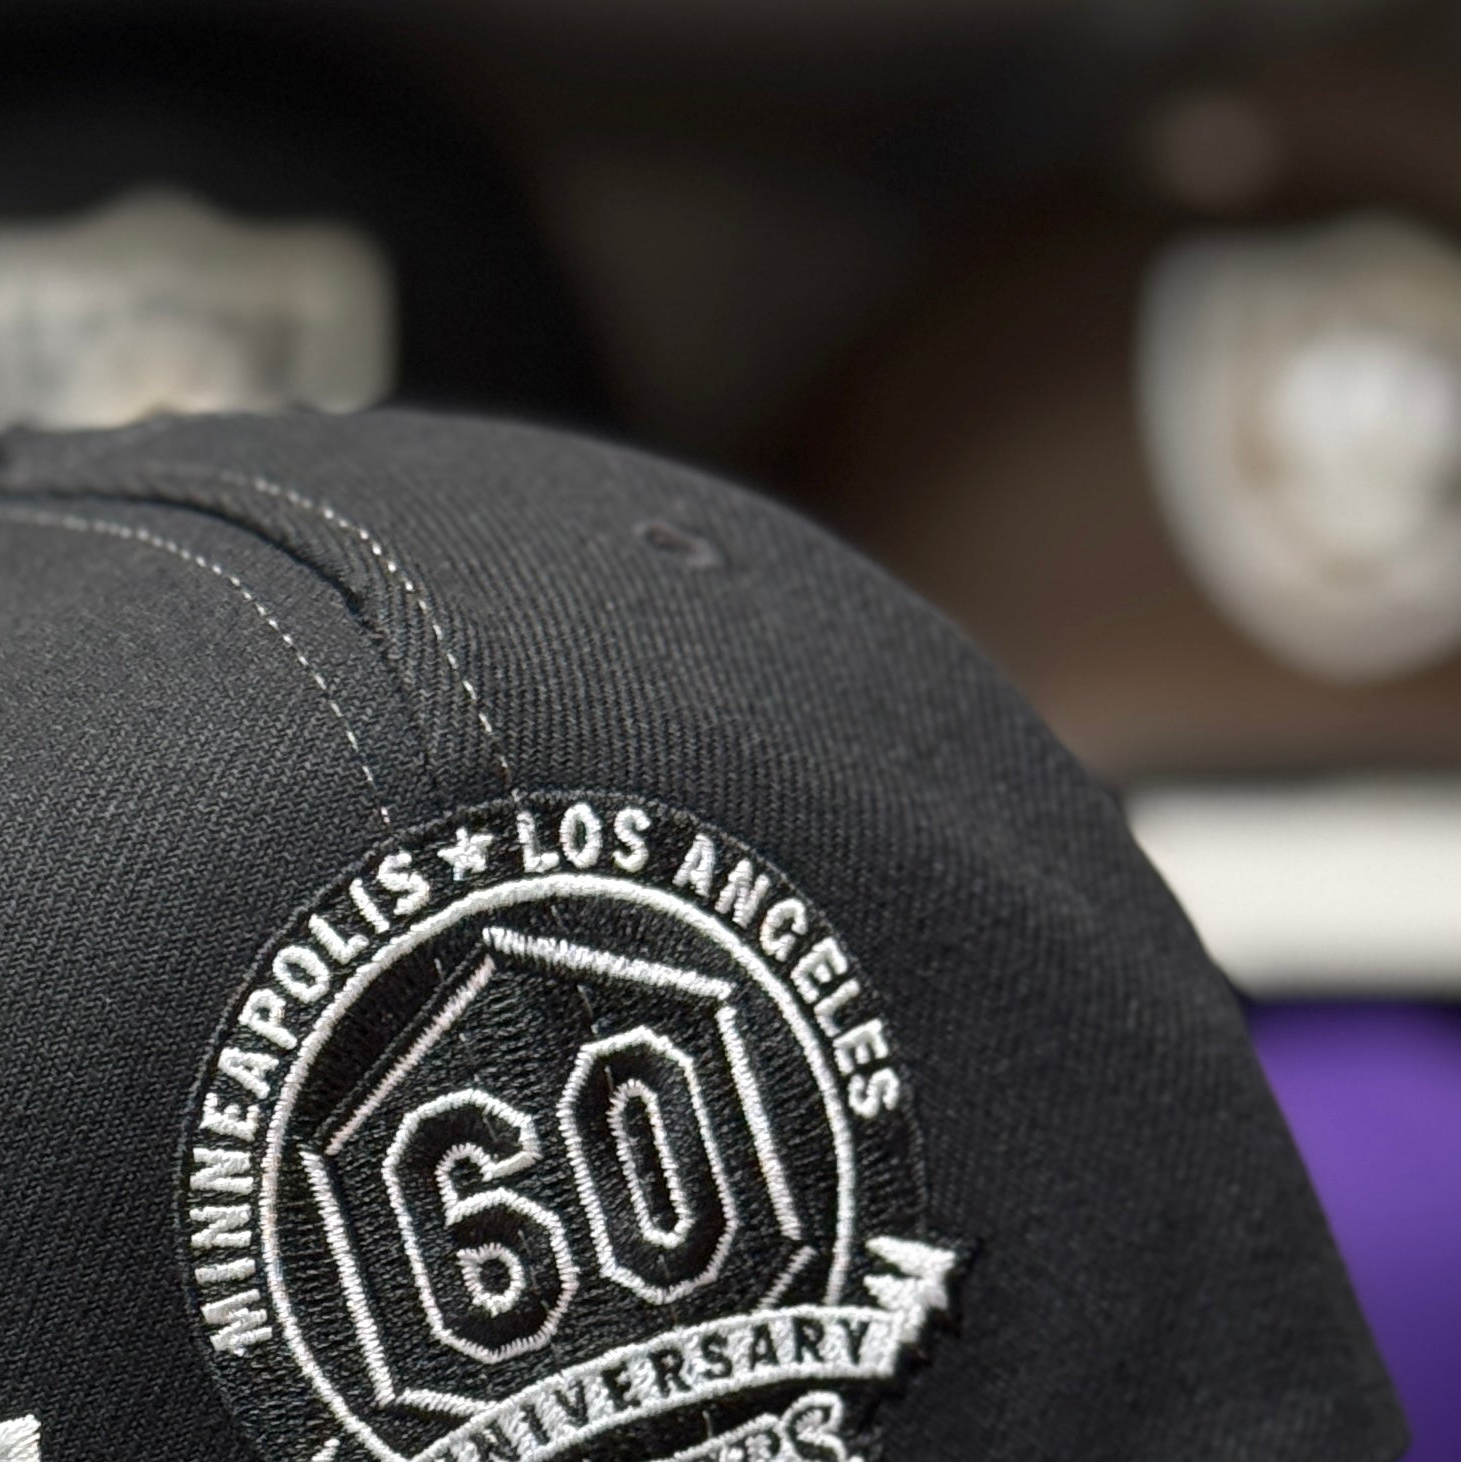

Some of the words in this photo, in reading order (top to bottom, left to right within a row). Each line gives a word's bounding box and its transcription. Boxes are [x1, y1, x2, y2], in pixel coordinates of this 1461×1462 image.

[188, 850, 430, 1356] MINNEAPOLIS
[516, 802, 651, 874] LOS
[672, 832, 900, 1122] ANGELES
[383, 1024, 741, 1366] 60
